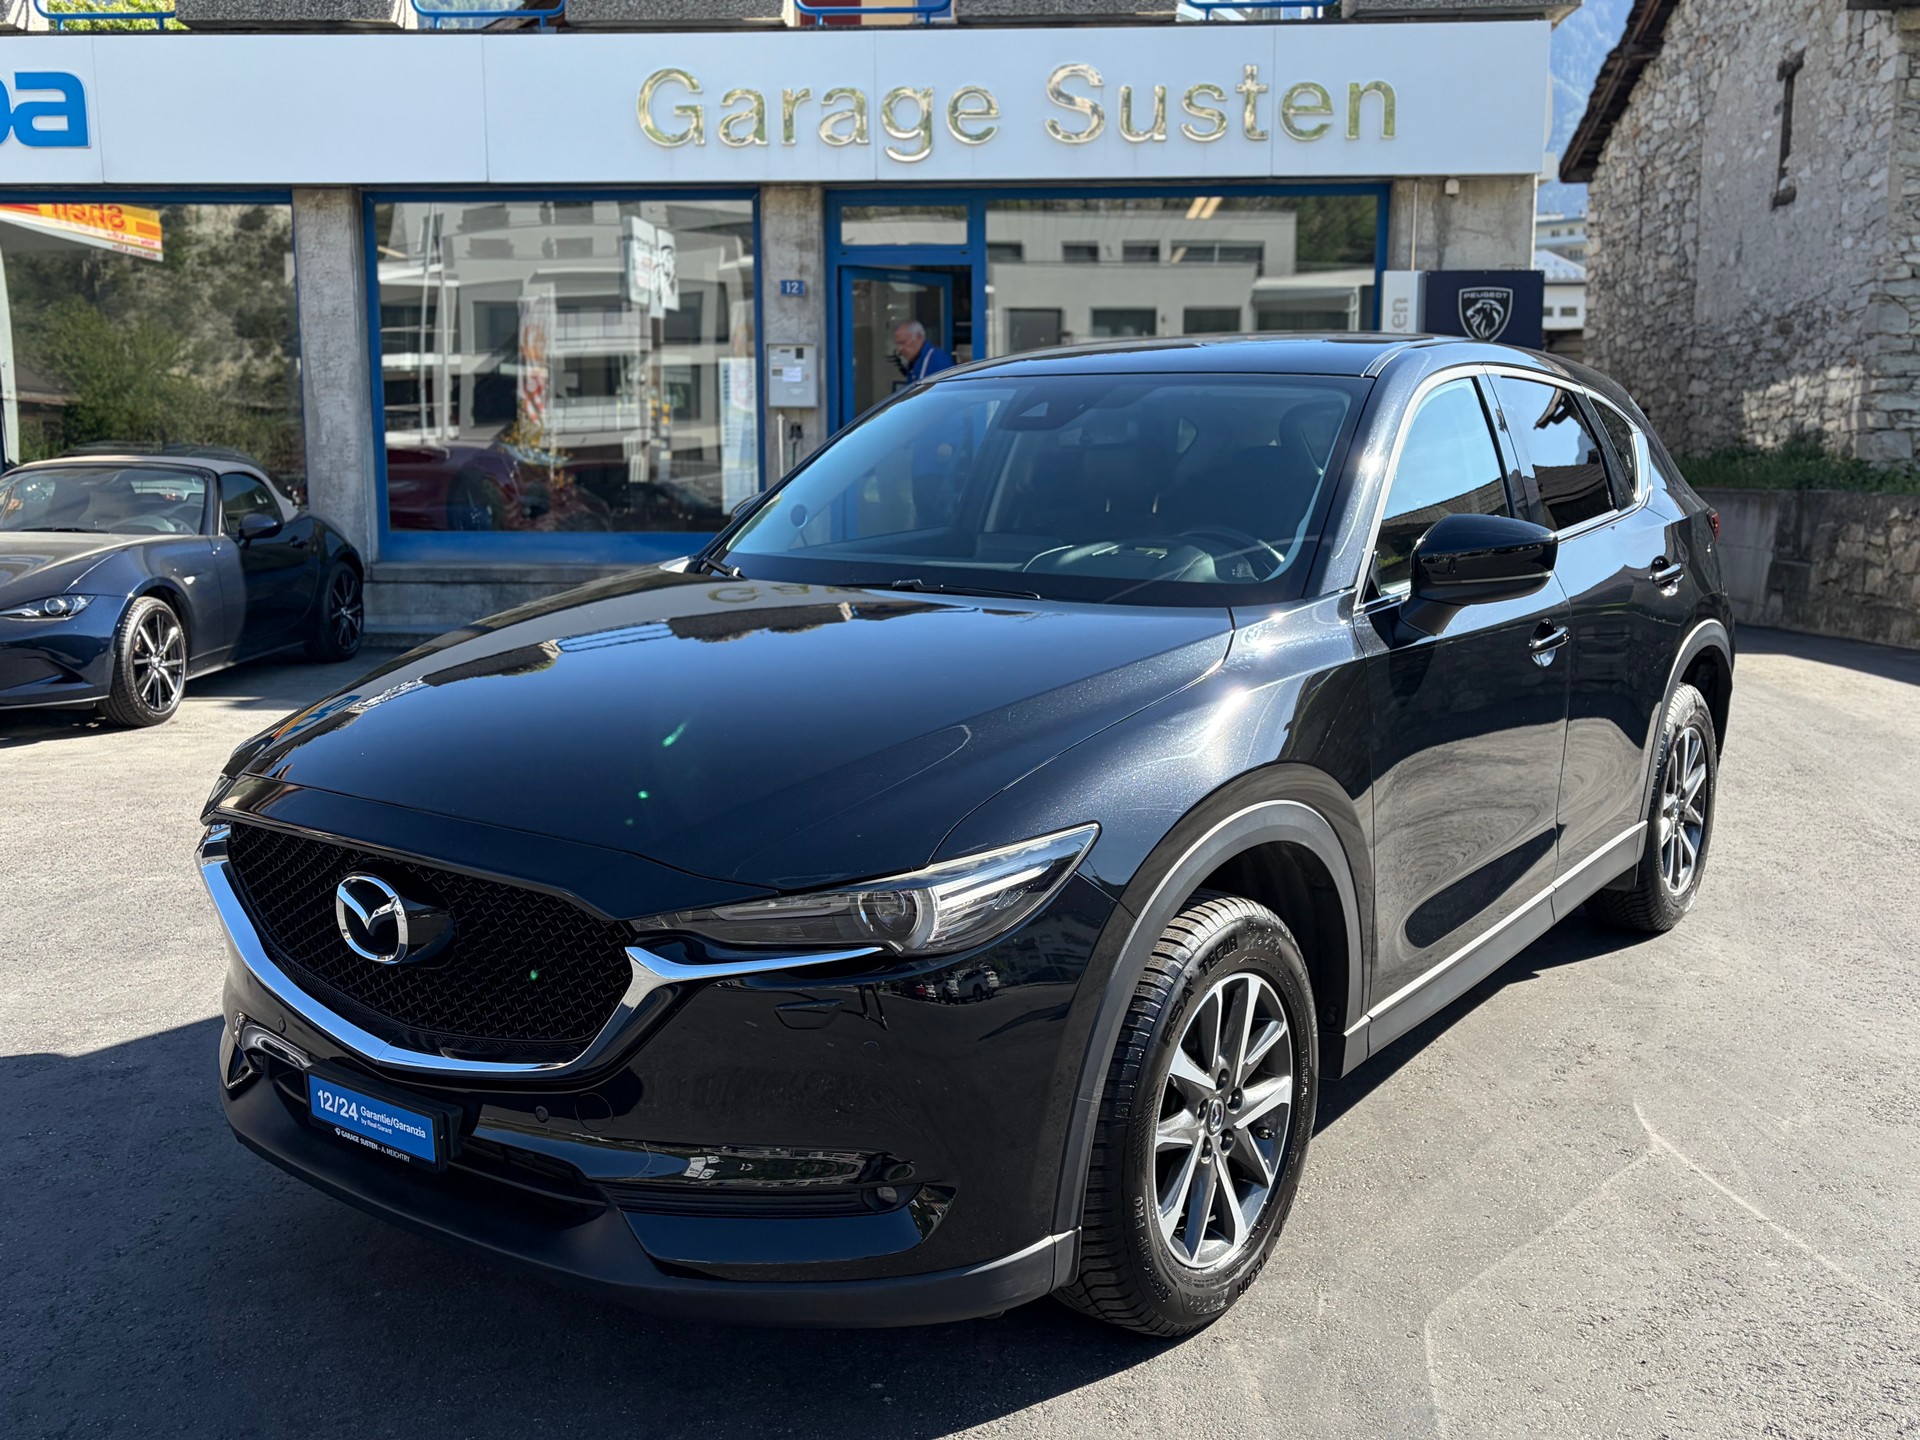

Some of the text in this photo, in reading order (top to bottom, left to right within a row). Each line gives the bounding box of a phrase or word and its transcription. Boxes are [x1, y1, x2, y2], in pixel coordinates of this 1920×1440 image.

[0, 72, 91, 148] a
[637, 63, 1397, 163] Garage Susten
[785, 281, 799, 294] 12
[1463, 291, 1508, 300] PEUGEOT
[1391, 297, 1409, 332] en
[317, 1089, 427, 1139] 12/24 Garantie/Garanzia
[340, 1130, 360, 1143] GARAGE
[360, 1137, 379, 1150] SUSTEN
